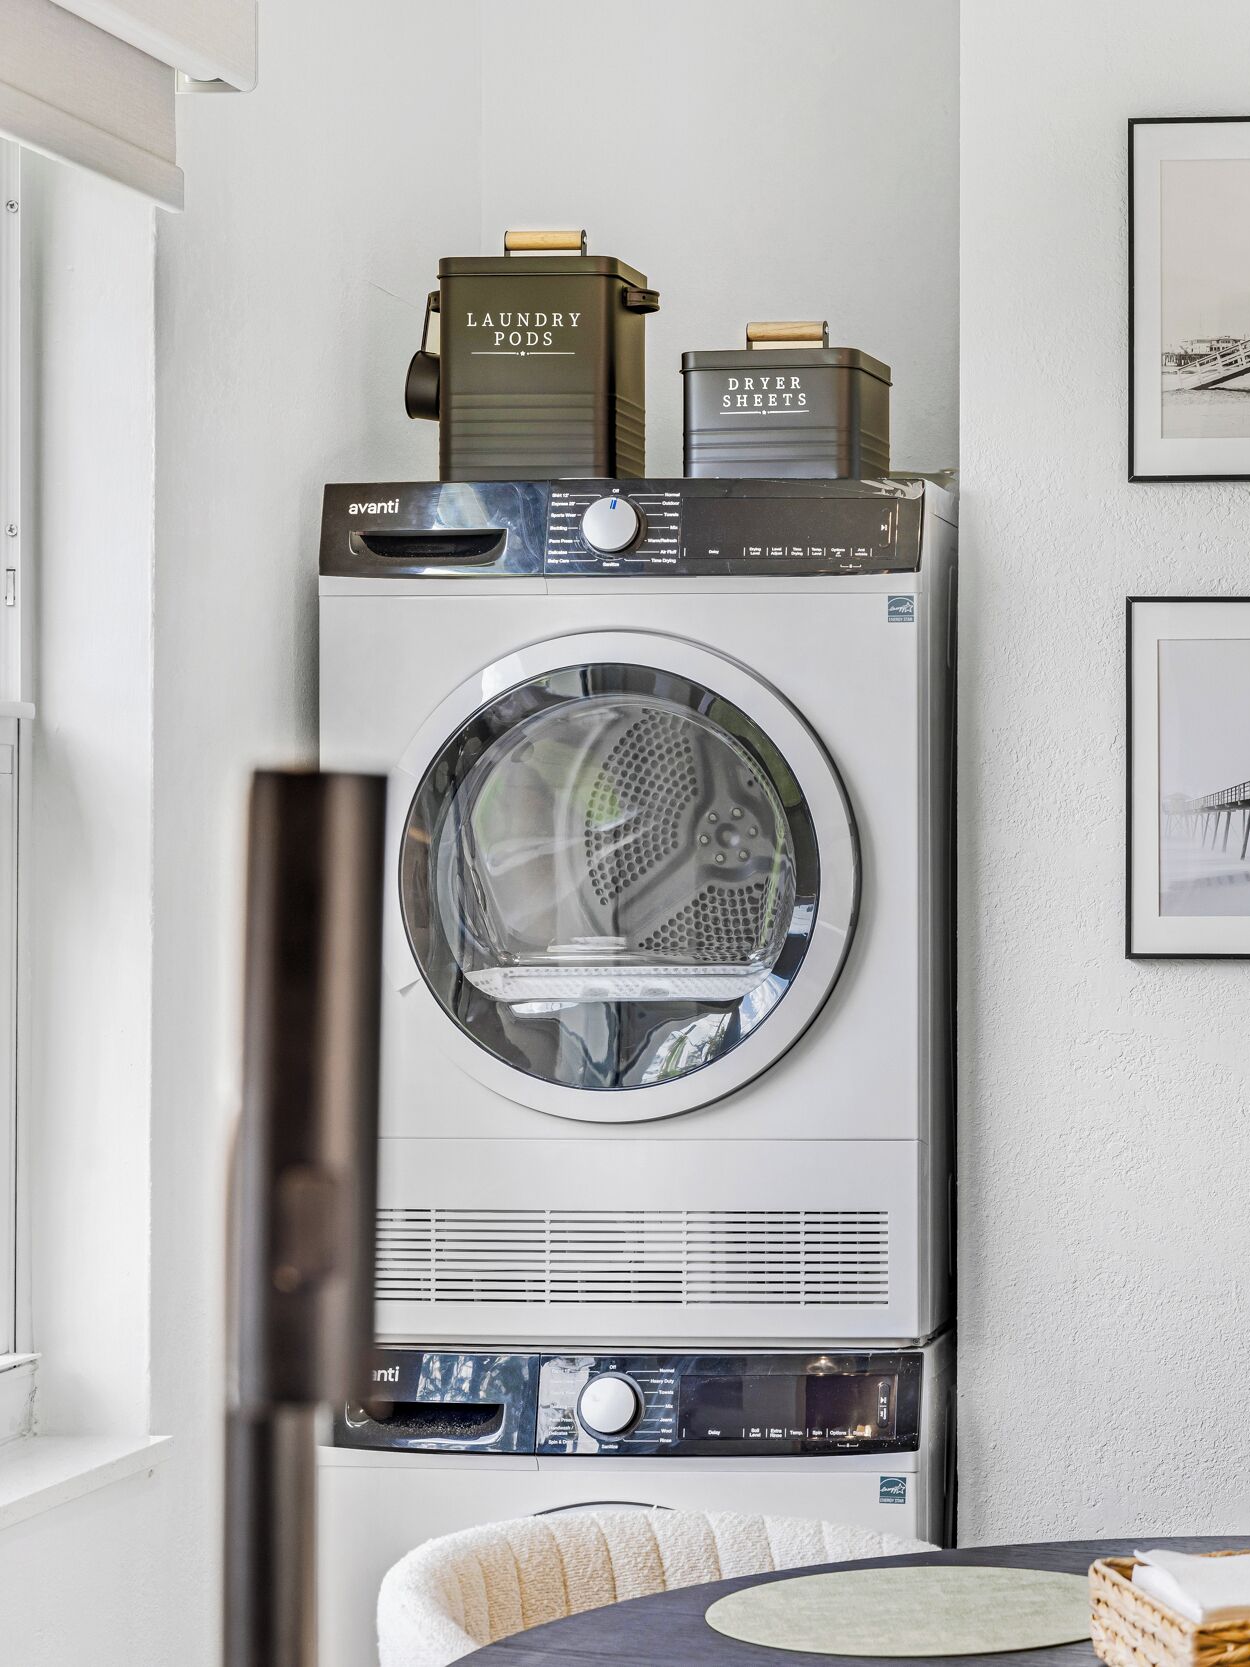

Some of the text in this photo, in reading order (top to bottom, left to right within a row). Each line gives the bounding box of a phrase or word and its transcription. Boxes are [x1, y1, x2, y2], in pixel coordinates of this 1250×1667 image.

[467, 313, 580, 327] LAUNDRY
[494, 332, 553, 346] PODS
[728, 377, 800, 390] DRYER
[723, 393, 807, 407] SHEETS
[348, 499, 400, 515] avanti
[372, 1366, 400, 1382] anti
